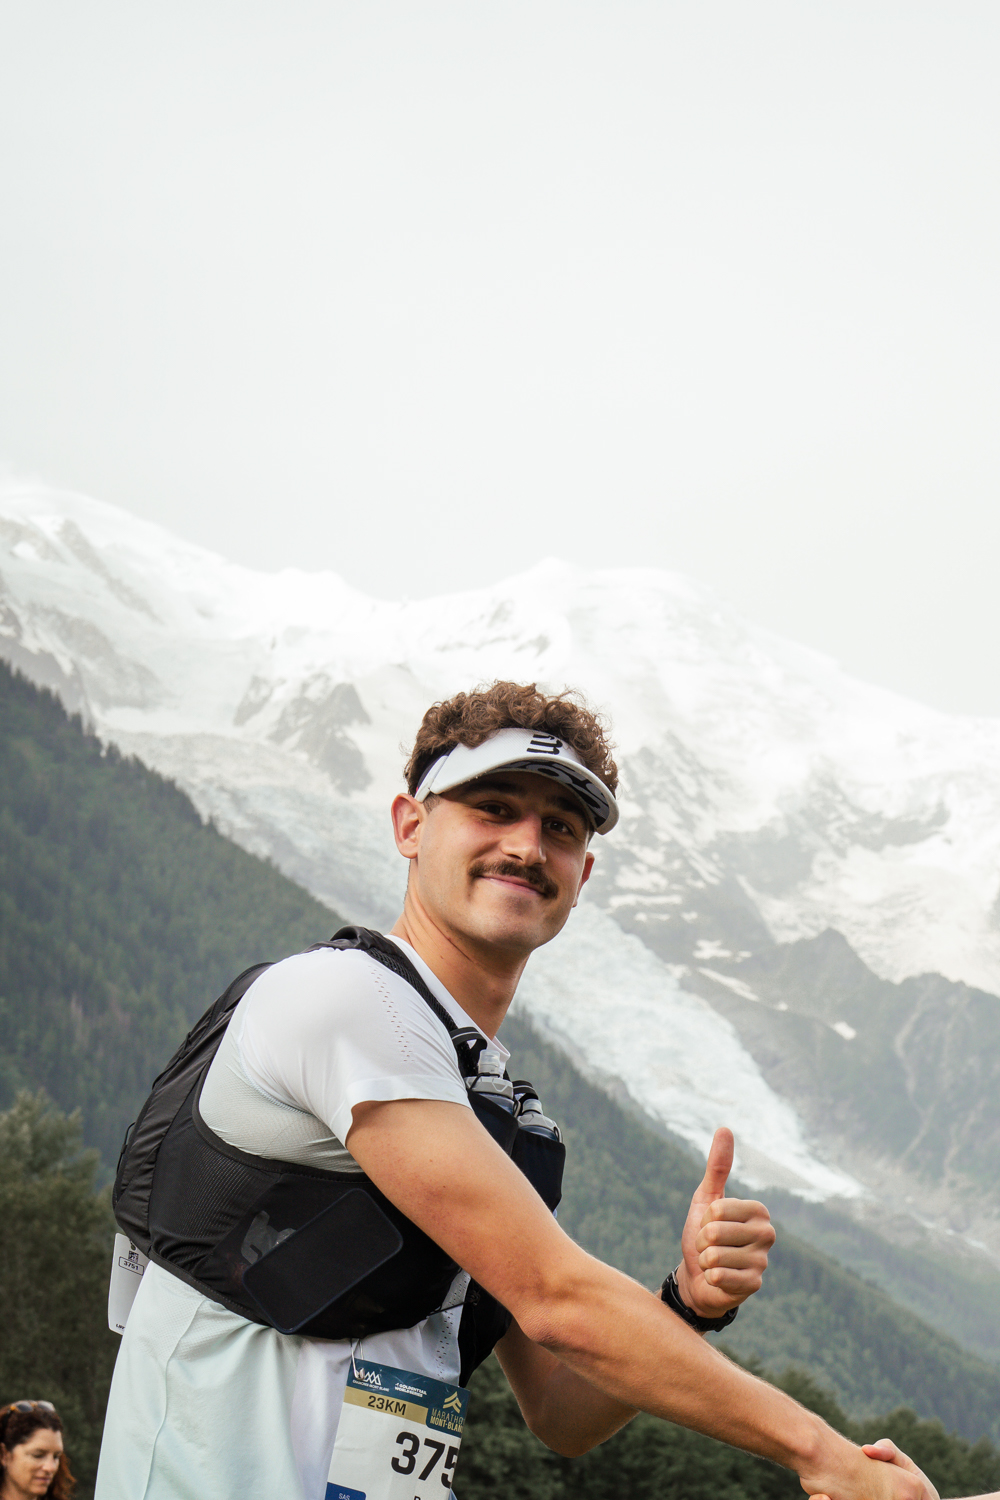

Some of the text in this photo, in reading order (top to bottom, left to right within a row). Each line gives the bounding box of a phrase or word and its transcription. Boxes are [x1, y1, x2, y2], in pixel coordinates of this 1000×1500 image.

[123, 1260, 139, 1271] 3751
[367, 1395, 407, 1416] 23KM
[431, 1407, 465, 1425] MARATHO
